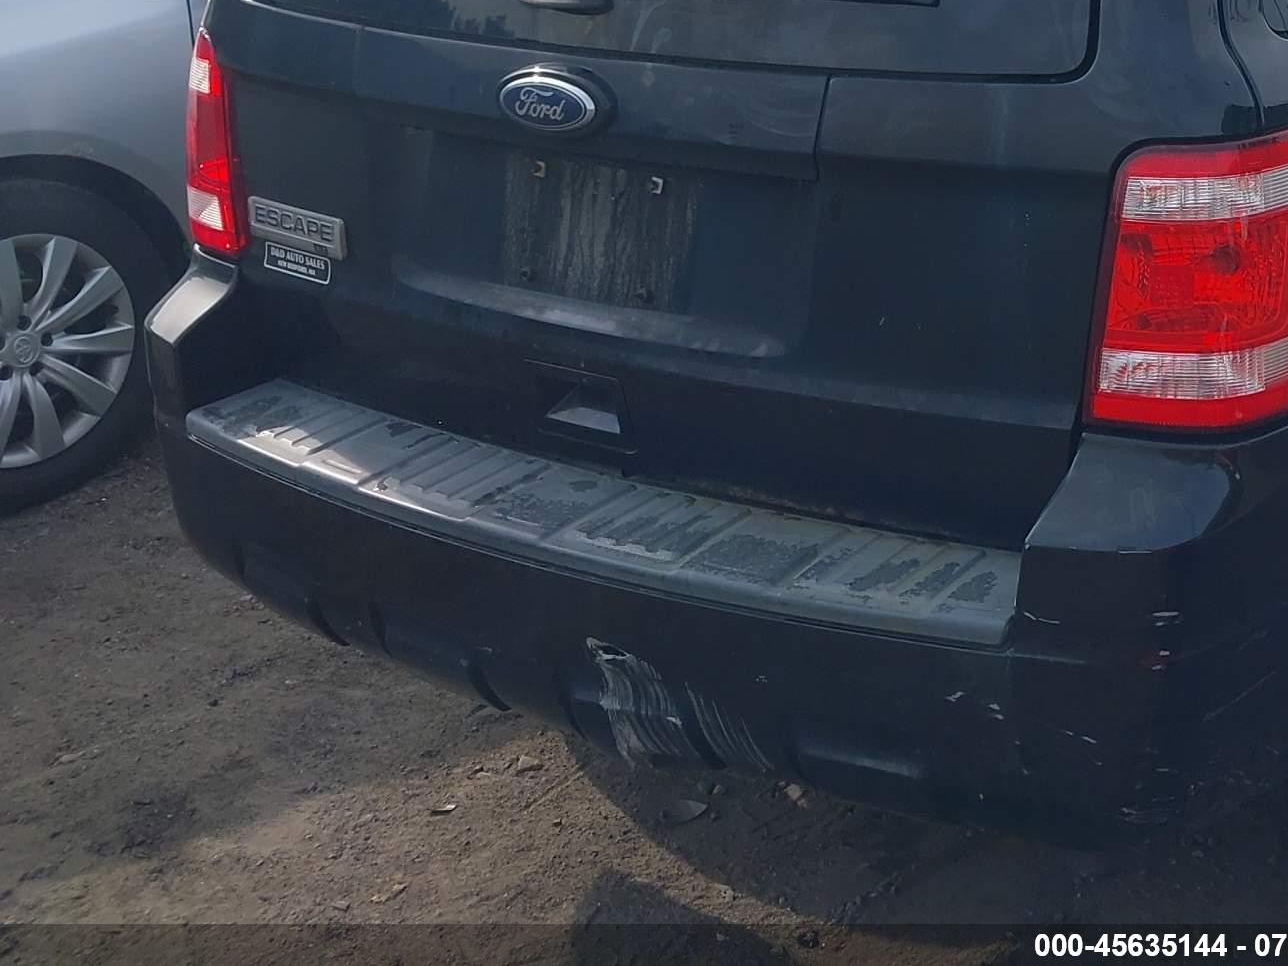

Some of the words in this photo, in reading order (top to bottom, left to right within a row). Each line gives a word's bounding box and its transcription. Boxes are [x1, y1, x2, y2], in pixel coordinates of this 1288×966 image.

[515, 87, 567, 121] Ford
[255, 204, 333, 242] ESCAPE
[286, 251, 304, 264] AUTO
[305, 256, 325, 270] SALES
